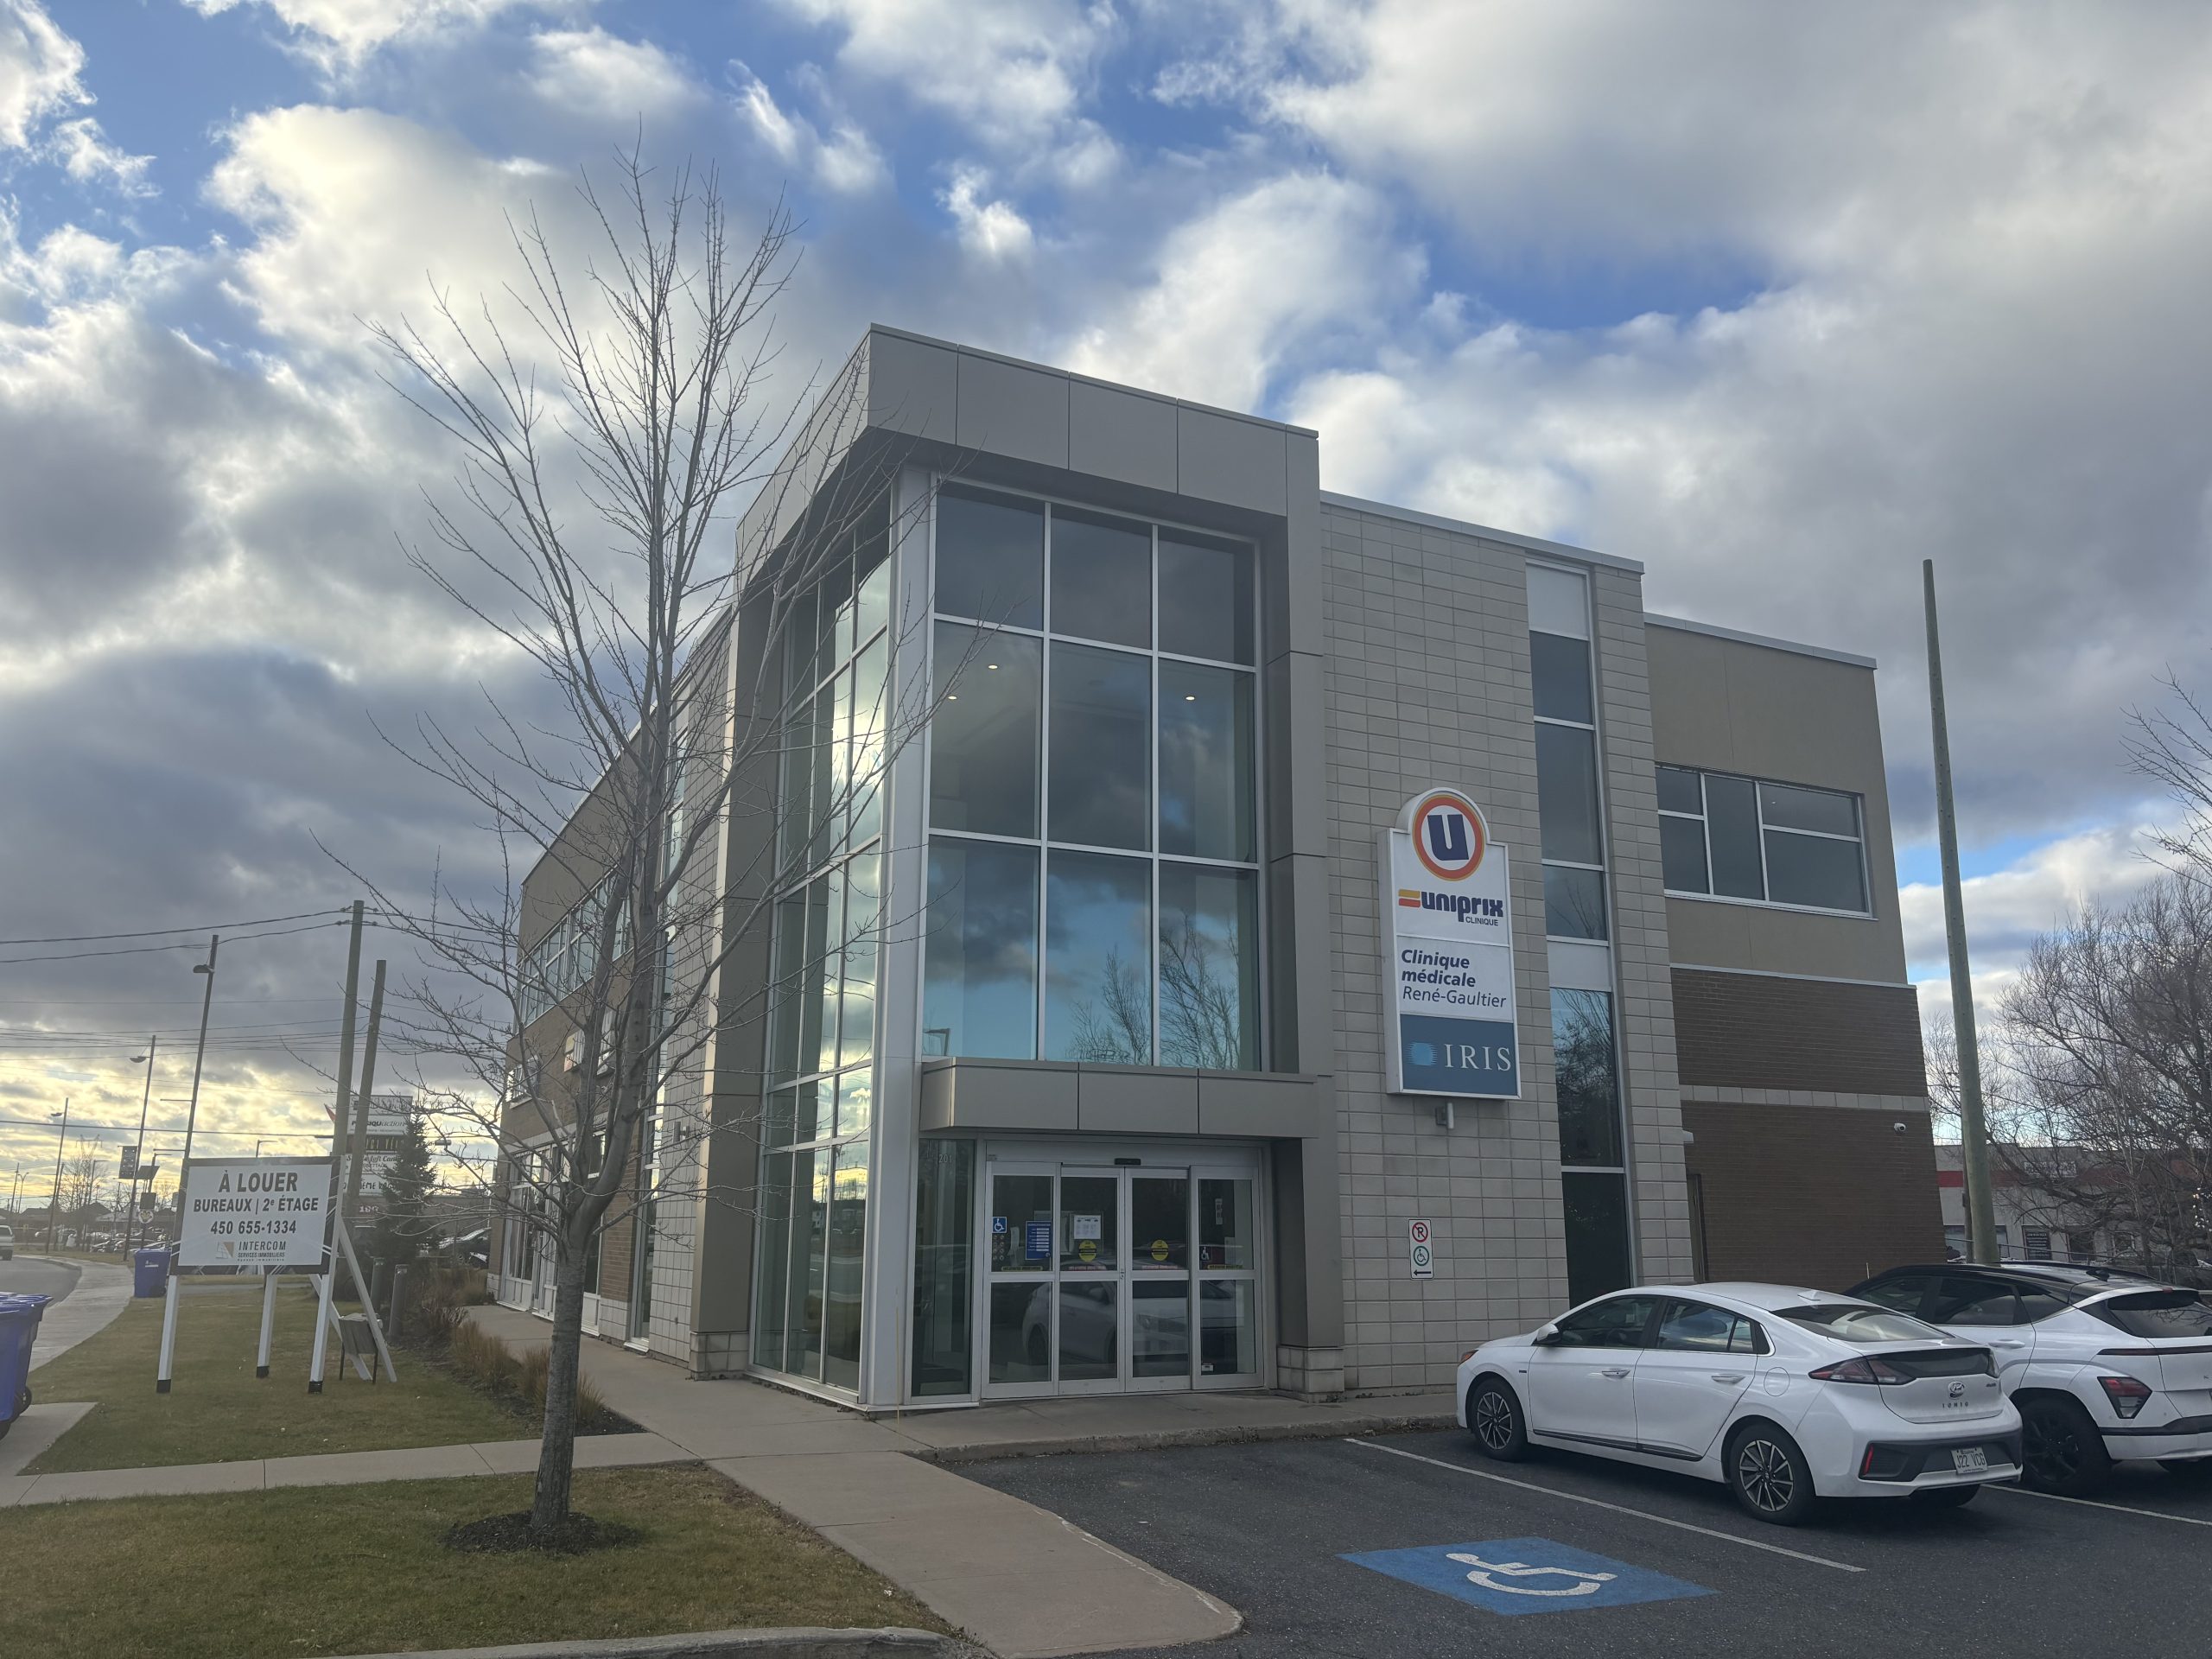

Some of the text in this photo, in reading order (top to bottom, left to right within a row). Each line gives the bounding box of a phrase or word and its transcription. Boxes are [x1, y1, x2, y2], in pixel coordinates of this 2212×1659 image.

[1421, 891, 1503, 923] uniprix
[1465, 916, 1499, 926] CLINIQUE
[1401, 949, 1470, 969] Clinique
[1402, 969, 1476, 987] médicale
[1402, 985, 1507, 1008] René-Gaultier
[1444, 1043, 1511, 1071] IRIS
[219, 1169, 298, 1193] À LOUER
[193, 1198, 253, 1212] BUREAUX
[277, 1194, 319, 1211] ÉTAGE
[210, 1219, 296, 1235] 450 655-1334
[238, 1240, 286, 1251] INTERCOM
